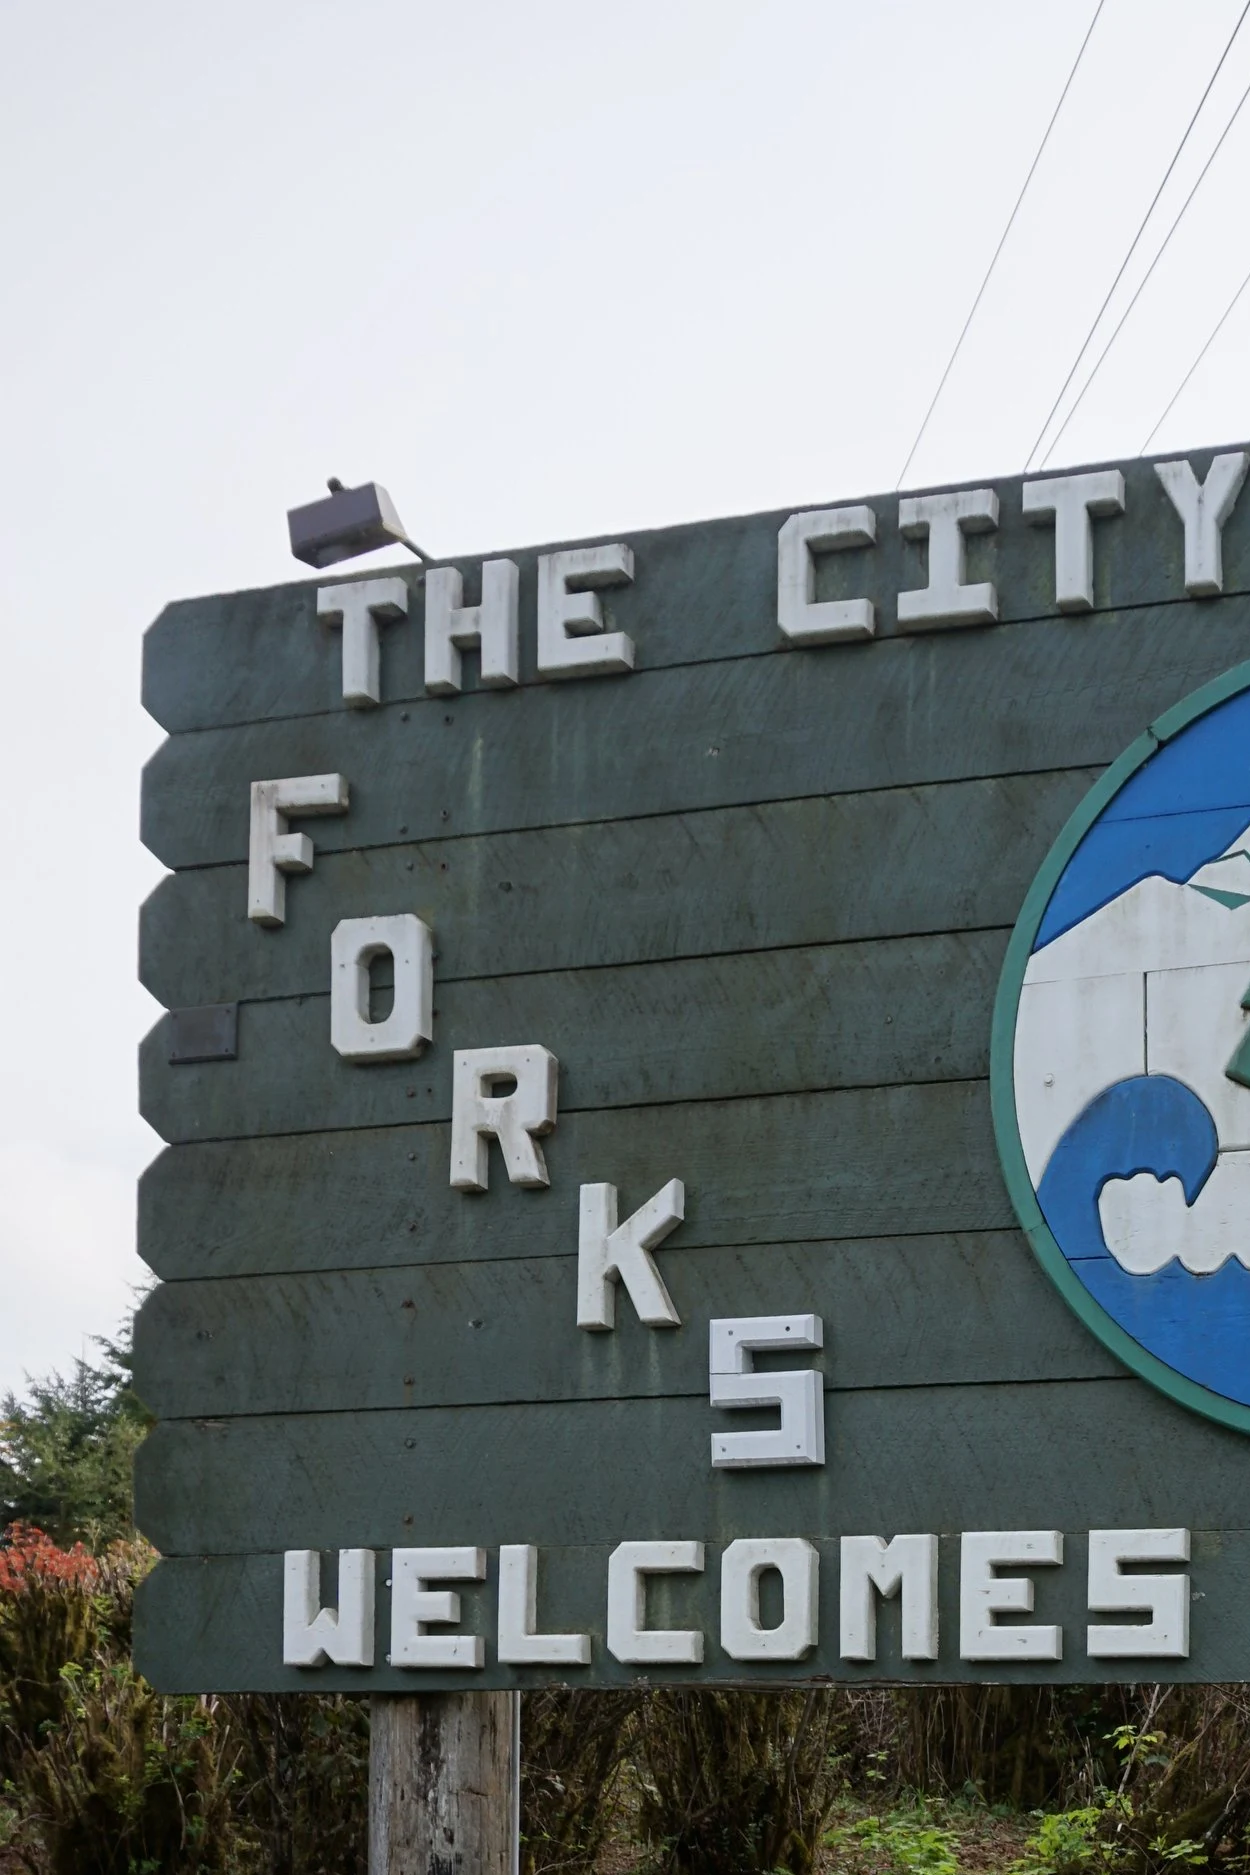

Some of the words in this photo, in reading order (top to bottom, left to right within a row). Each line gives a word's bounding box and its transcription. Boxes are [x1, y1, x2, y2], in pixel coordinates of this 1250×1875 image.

[316, 543, 636, 710] THE
[246, 771, 828, 1469] FORKS
[282, 1526, 1193, 1670] WELCOMES
